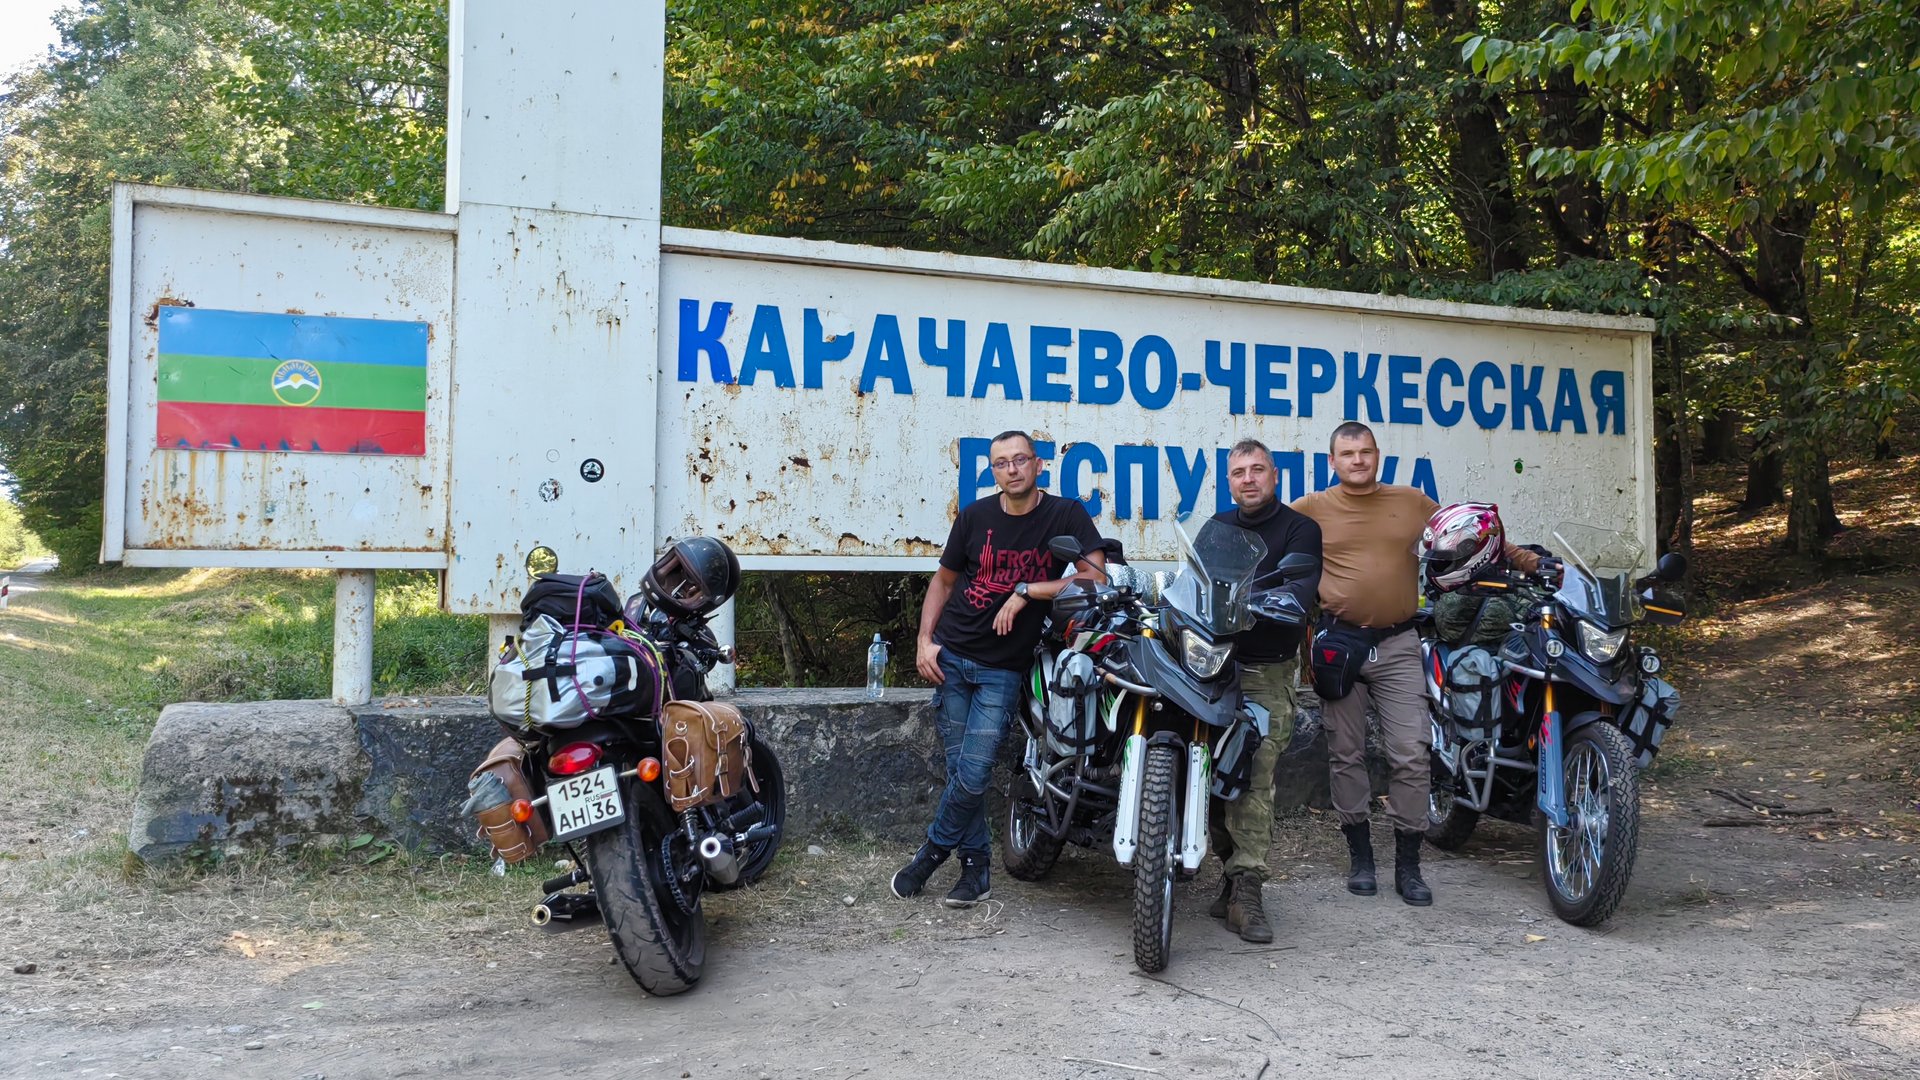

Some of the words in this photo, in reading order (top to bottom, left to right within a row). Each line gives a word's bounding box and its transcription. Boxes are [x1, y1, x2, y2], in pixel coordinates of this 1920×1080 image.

[677, 298, 1624, 434] КАРАЧАЕВО-ЧЕРКЕССКАЯ
[996, 548, 1052, 569] FROM
[558, 773, 605, 801] 1524
[585, 794, 600, 803] RUS
[592, 798, 617, 820] 36
